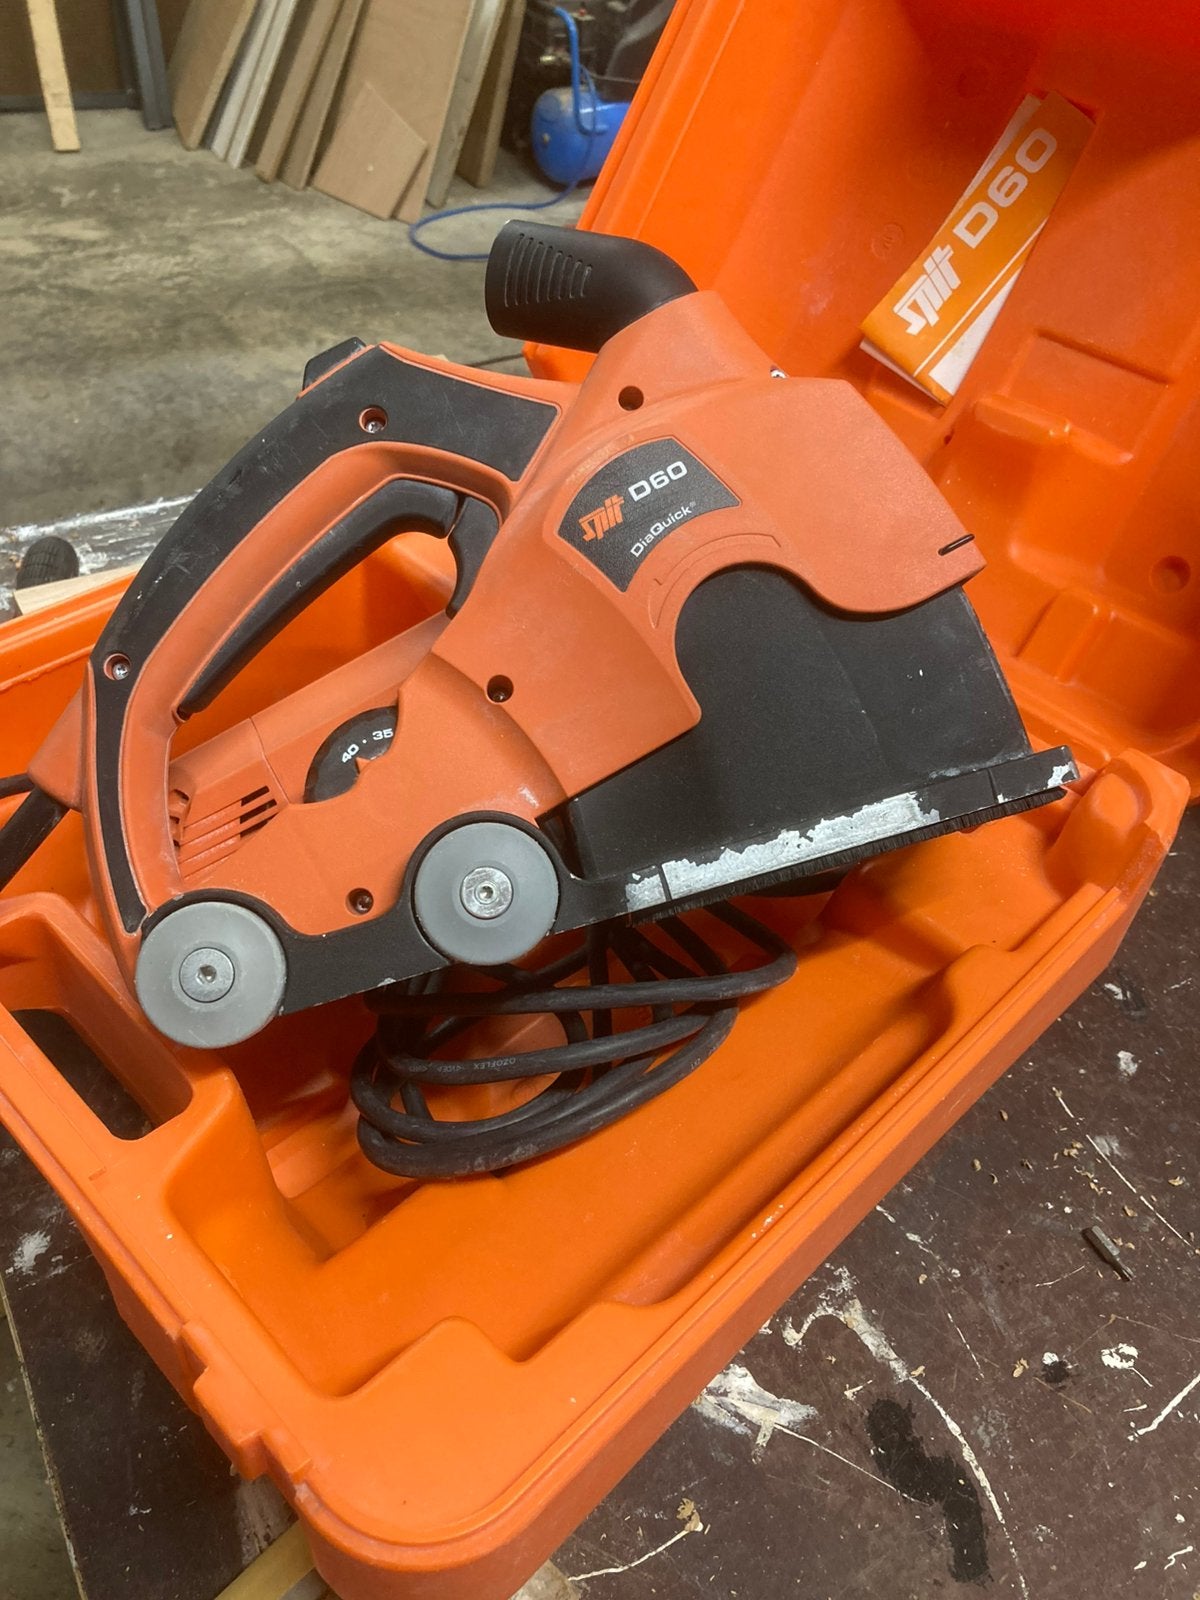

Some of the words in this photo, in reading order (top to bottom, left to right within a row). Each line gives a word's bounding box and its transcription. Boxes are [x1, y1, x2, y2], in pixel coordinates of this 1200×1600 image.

[952, 127, 1058, 249] D60
[628, 460, 688, 502] D60
[341, 744, 360, 763] 40
[372, 728, 394, 740] 35
[473, 1057, 516, 1070] OZOFLEX
